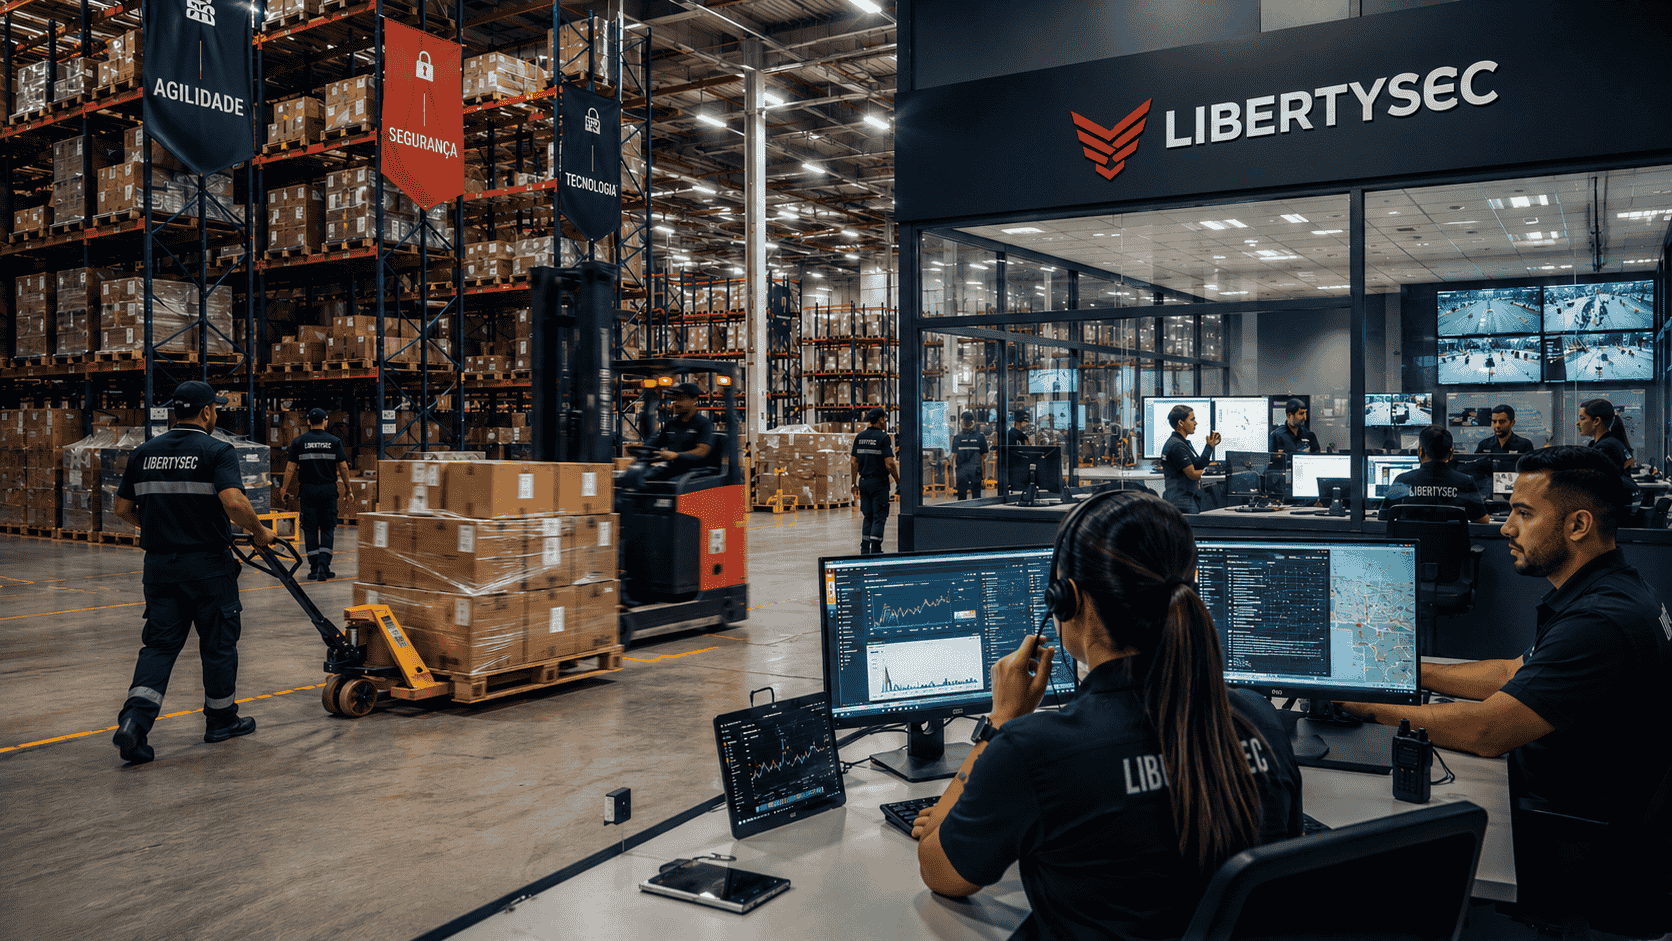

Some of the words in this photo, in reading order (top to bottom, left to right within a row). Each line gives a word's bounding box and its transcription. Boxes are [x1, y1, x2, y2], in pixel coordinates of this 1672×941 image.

[153, 78, 244, 116] AGILIDADE
[1166, 60, 1499, 149] LIBERTYSEC
[389, 127, 458, 159] SEGURANÇA
[565, 172, 617, 197] TECNOLOGIA
[143, 456, 199, 470] LIBERTYSEC
[1409, 486, 1458, 498] LIBERTYSEC
[1123, 738, 1269, 794] LIBEC
